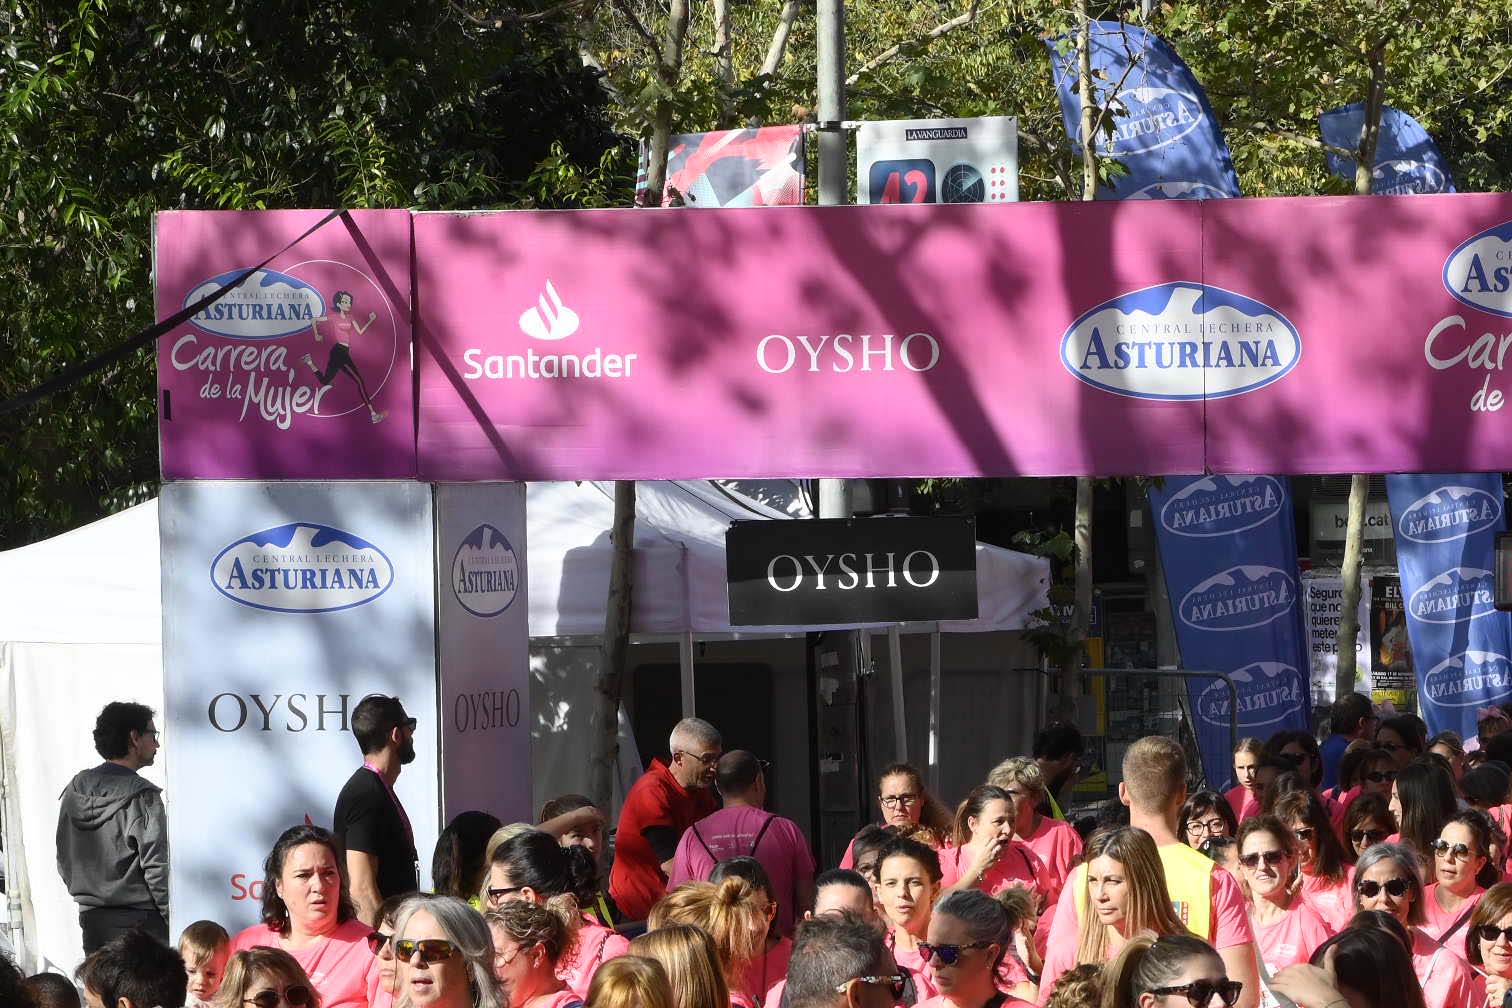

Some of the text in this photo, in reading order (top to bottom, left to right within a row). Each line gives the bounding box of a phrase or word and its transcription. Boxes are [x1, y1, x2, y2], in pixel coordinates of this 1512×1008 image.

[194, 294, 313, 321] ASTURIANA
[1115, 322, 1274, 336] CENTRAL LECHERA
[171, 334, 288, 371] Carrera
[463, 348, 637, 379] Santander
[756, 333, 940, 373] OYSHO
[1080, 325, 1281, 371] ASTURIANA
[200, 368, 333, 430] de la Mujer
[1470, 371, 1503, 413] de
[1334, 513, 1388, 529] b.cat
[225, 556, 381, 591] ASTURIANA
[253, 553, 375, 563] CENTRAL LECHERA
[457, 558, 516, 595] ASTURIANA
[767, 550, 940, 592] OYSHO
[1311, 615, 1342, 628] quiere
[208, 692, 395, 733] OYSH
[454, 688, 521, 734] OYSHO
